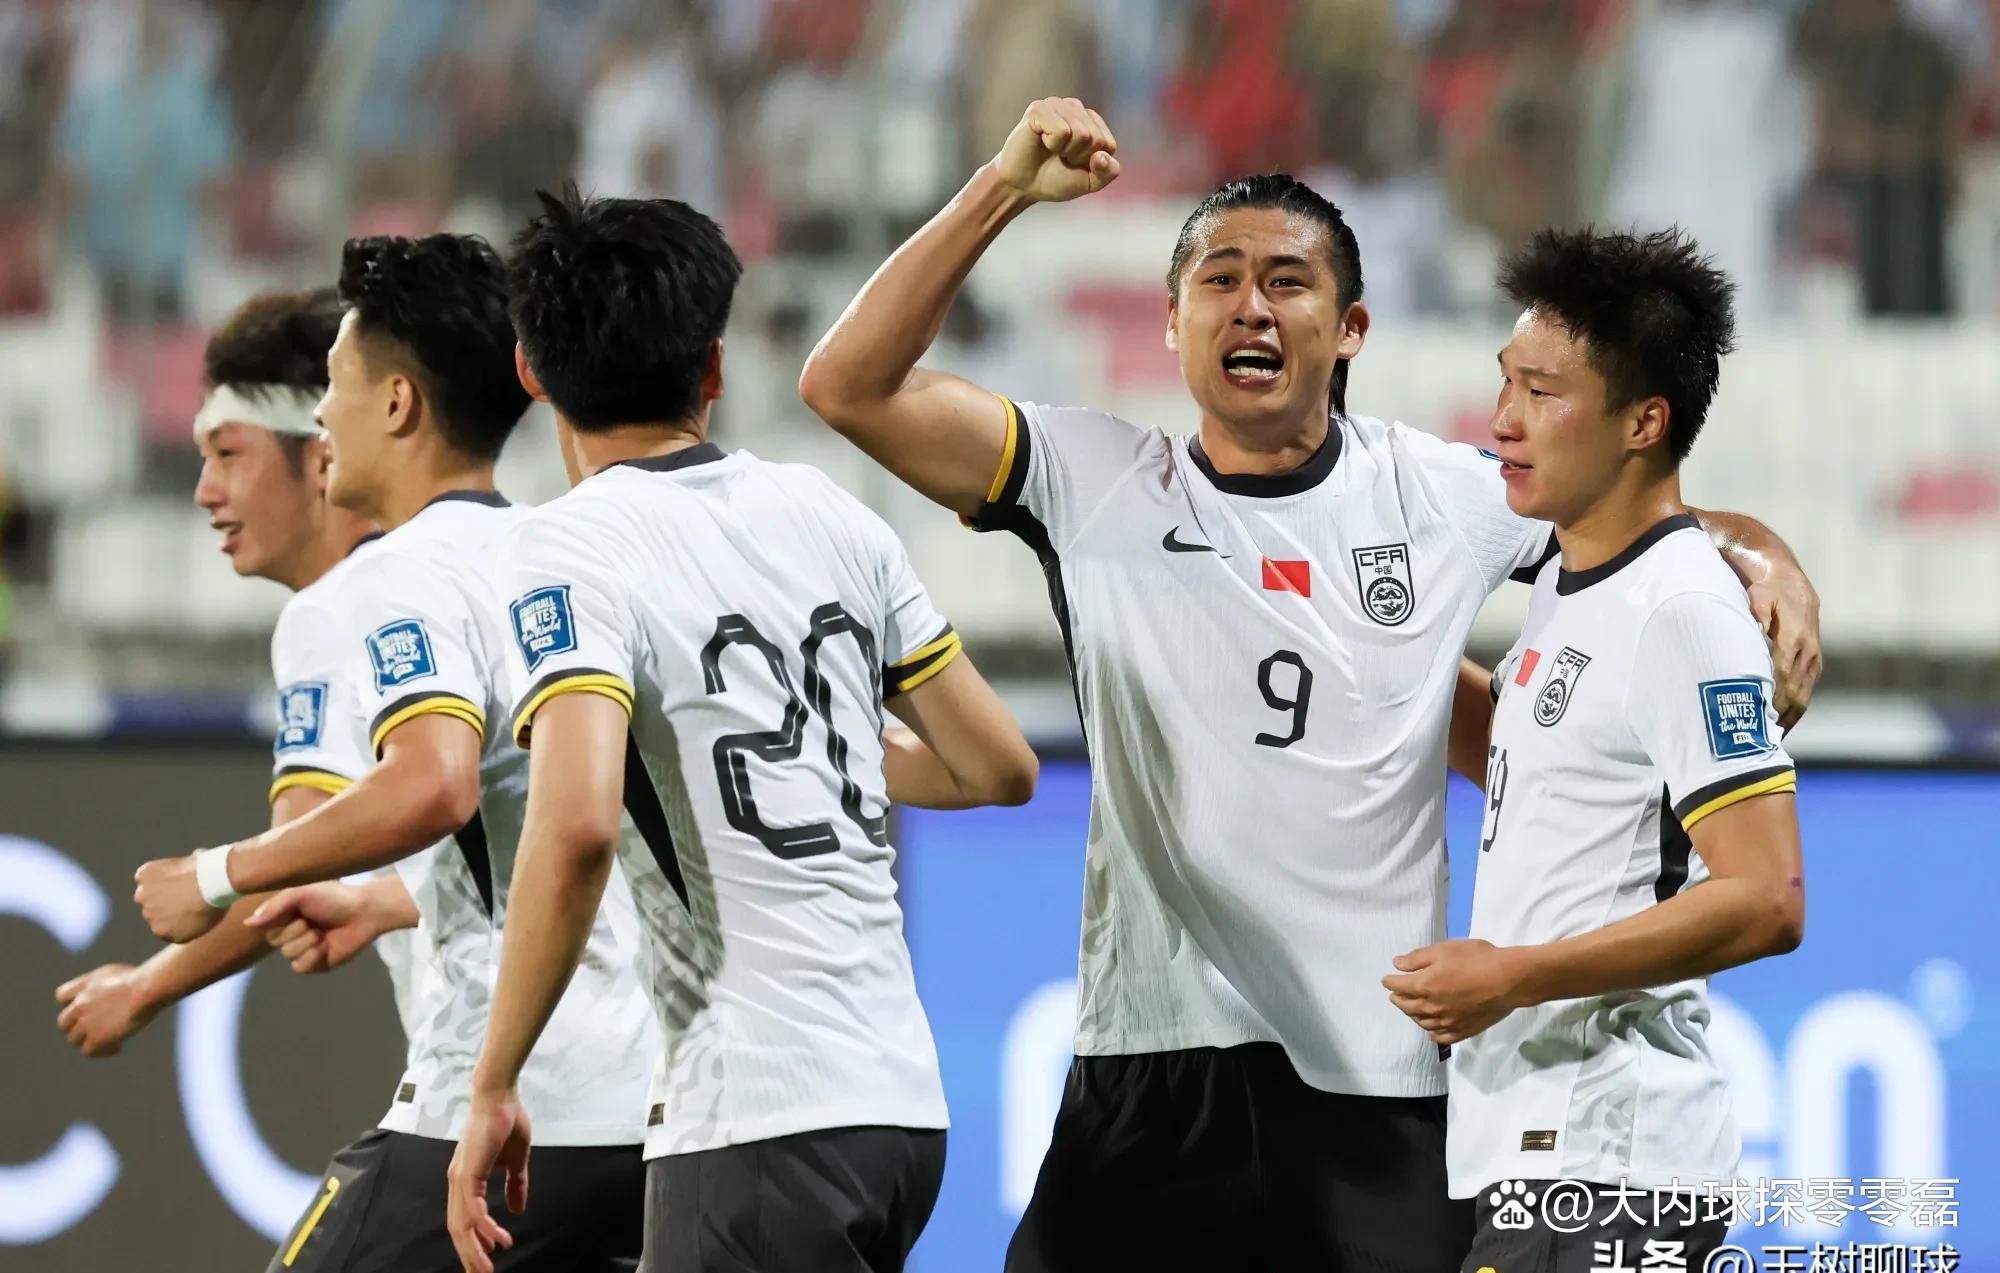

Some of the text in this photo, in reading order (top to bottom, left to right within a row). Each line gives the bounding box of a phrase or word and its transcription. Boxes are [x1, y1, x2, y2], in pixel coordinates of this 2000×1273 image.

[1358, 549, 1404, 567] CFA
[1374, 565, 1393, 575] 中国
[1557, 651, 1585, 672] CFA
[1255, 649, 1313, 748] 9
[1716, 692, 1754, 704] FOOTBALL
[1718, 703, 1756, 719] UNITES
[700, 601, 890, 860] 20
[1718, 717, 1758, 732] the World
